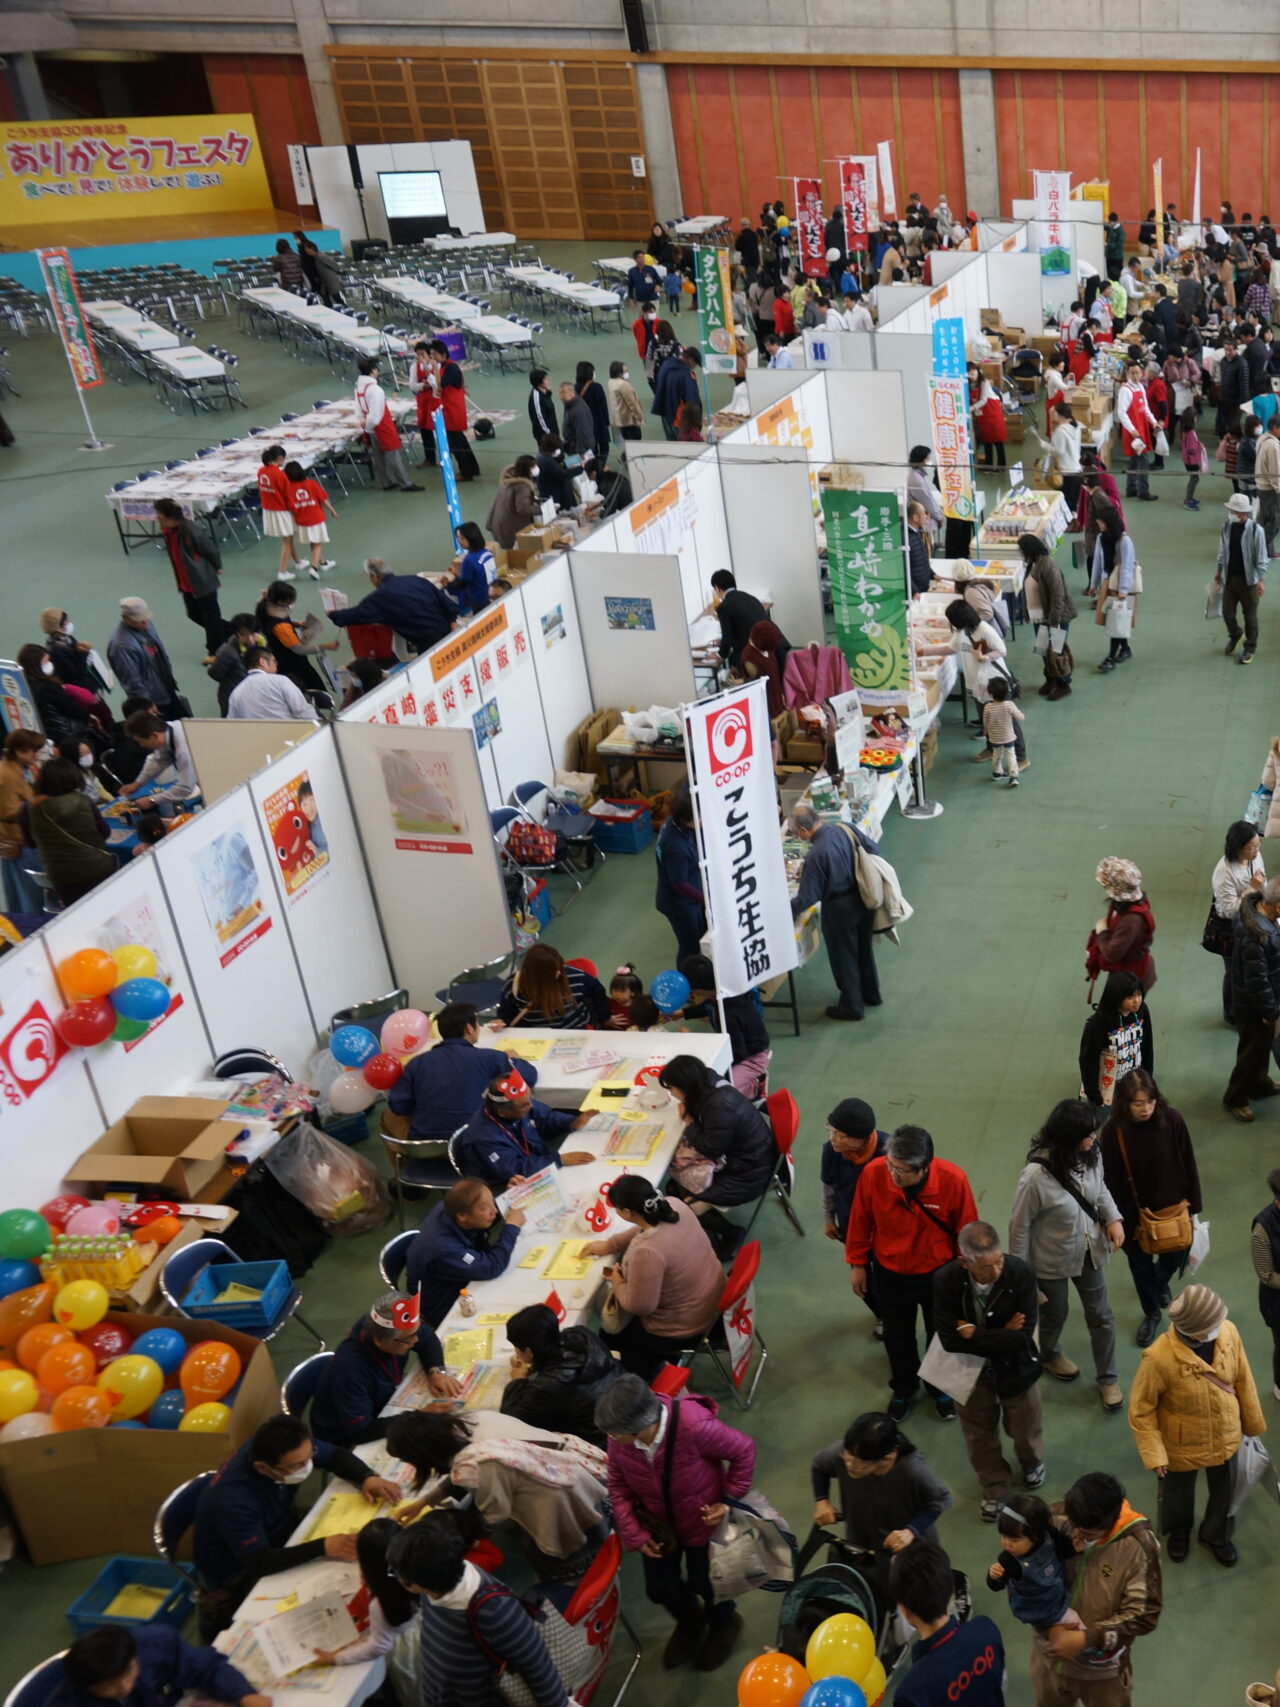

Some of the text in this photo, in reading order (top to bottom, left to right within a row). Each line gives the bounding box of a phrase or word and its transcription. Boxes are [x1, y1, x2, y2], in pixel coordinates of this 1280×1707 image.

[6, 130, 250, 176] ありがとうフェスタ
[702, 253, 722, 327] タケダハム
[847, 504, 884, 637] 真崎わかめ
[724, 785, 771, 982] こうち生協
